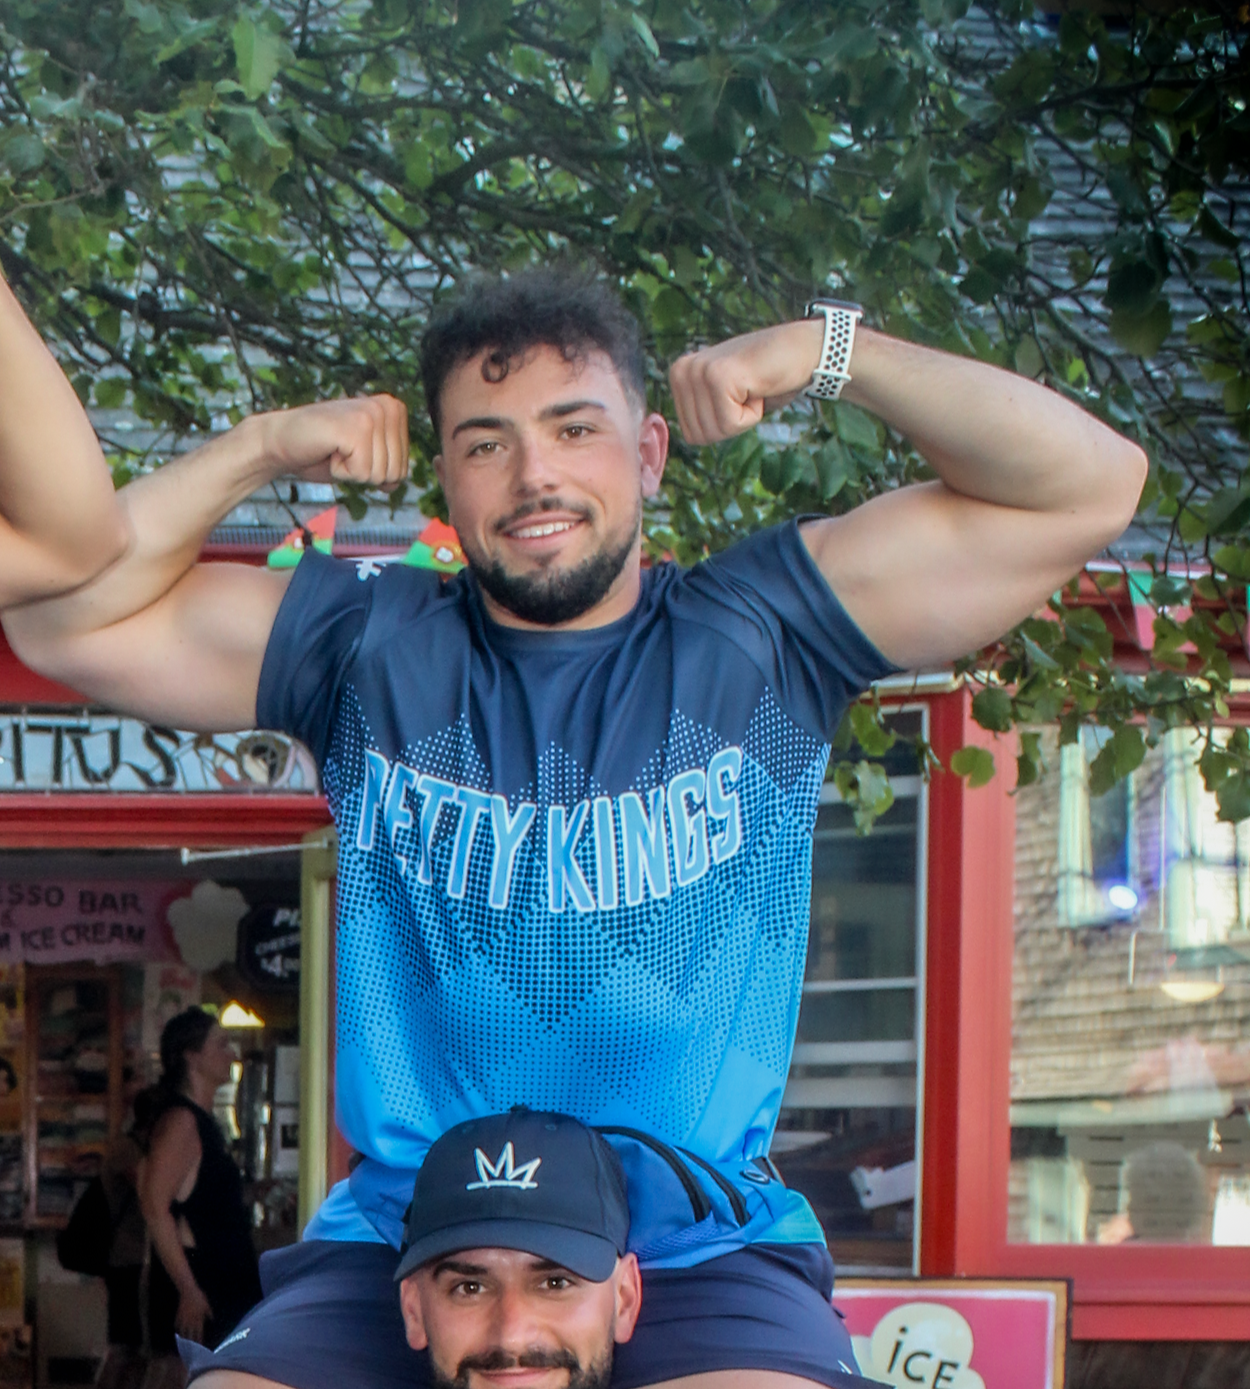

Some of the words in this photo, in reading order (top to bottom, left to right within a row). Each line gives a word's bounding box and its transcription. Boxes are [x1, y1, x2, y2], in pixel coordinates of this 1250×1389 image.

[357, 747, 537, 911] PETTY
[548, 745, 744, 914] KINGS
[78, 888, 143, 915] BAR
[20, 926, 55, 951] ICE
[60, 921, 146, 946] CREAM
